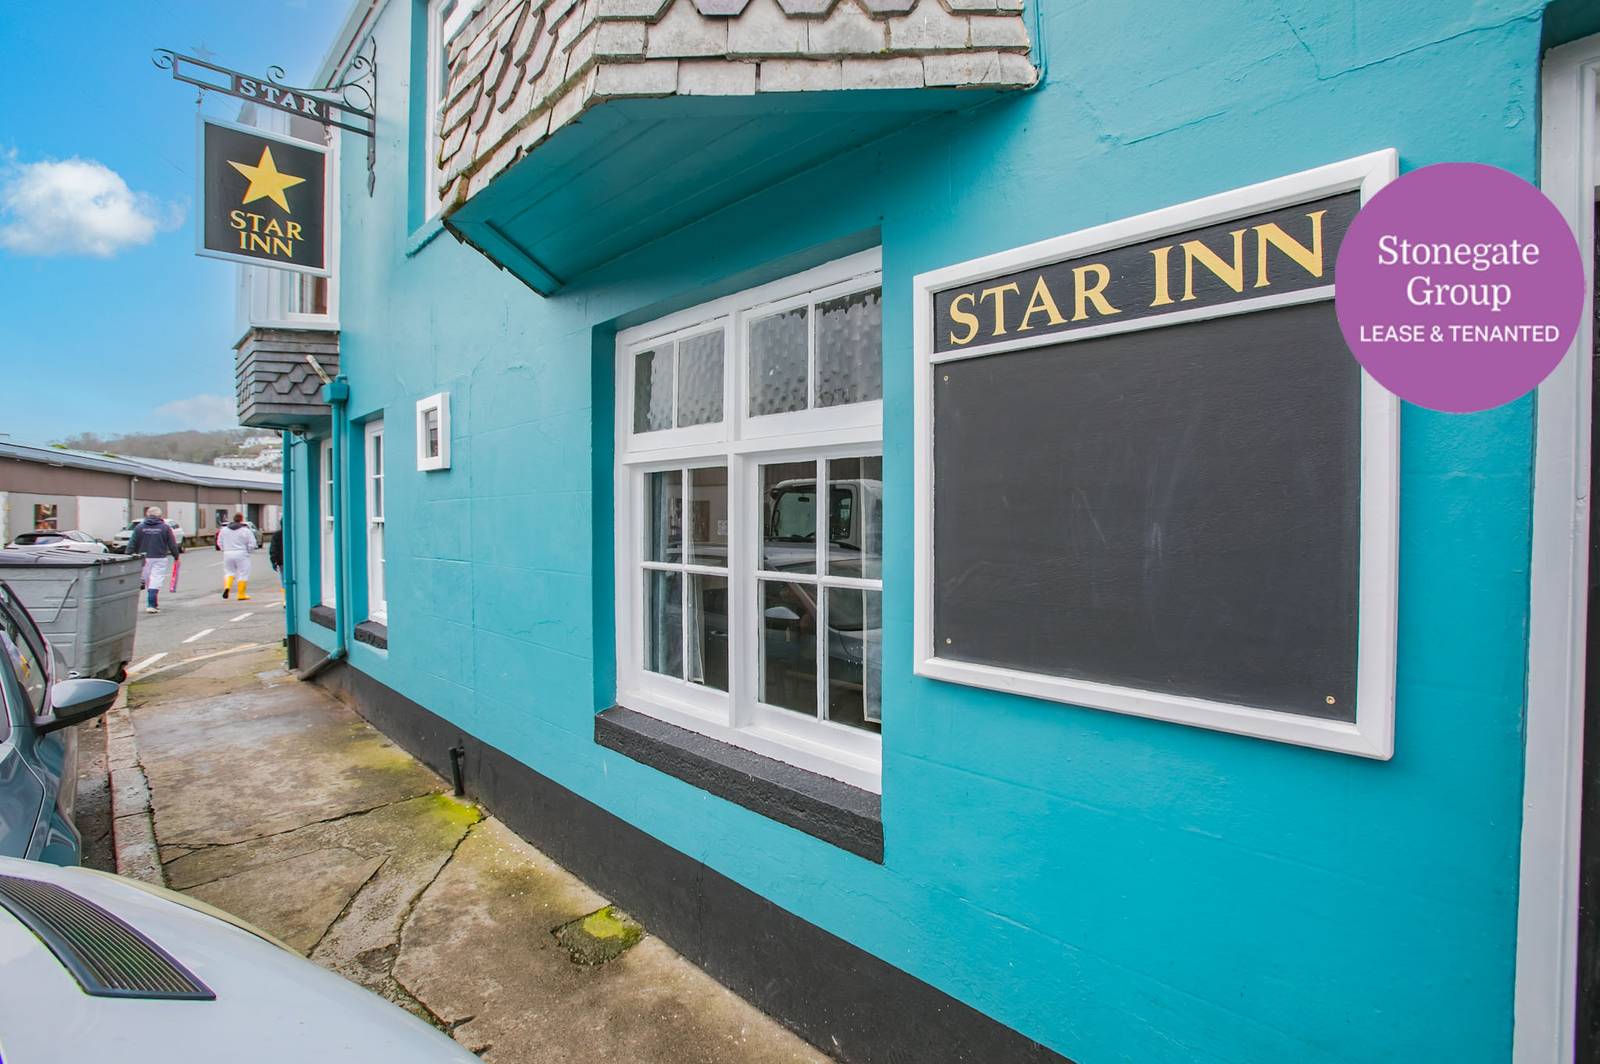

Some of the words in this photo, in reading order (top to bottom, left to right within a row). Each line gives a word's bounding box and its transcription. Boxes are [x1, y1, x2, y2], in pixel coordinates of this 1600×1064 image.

[240, 78, 319, 117] STAR
[229, 209, 304, 241] STAR
[239, 231, 293, 258] INN
[949, 262, 1122, 346] STAR
[1149, 209, 1328, 307] INN
